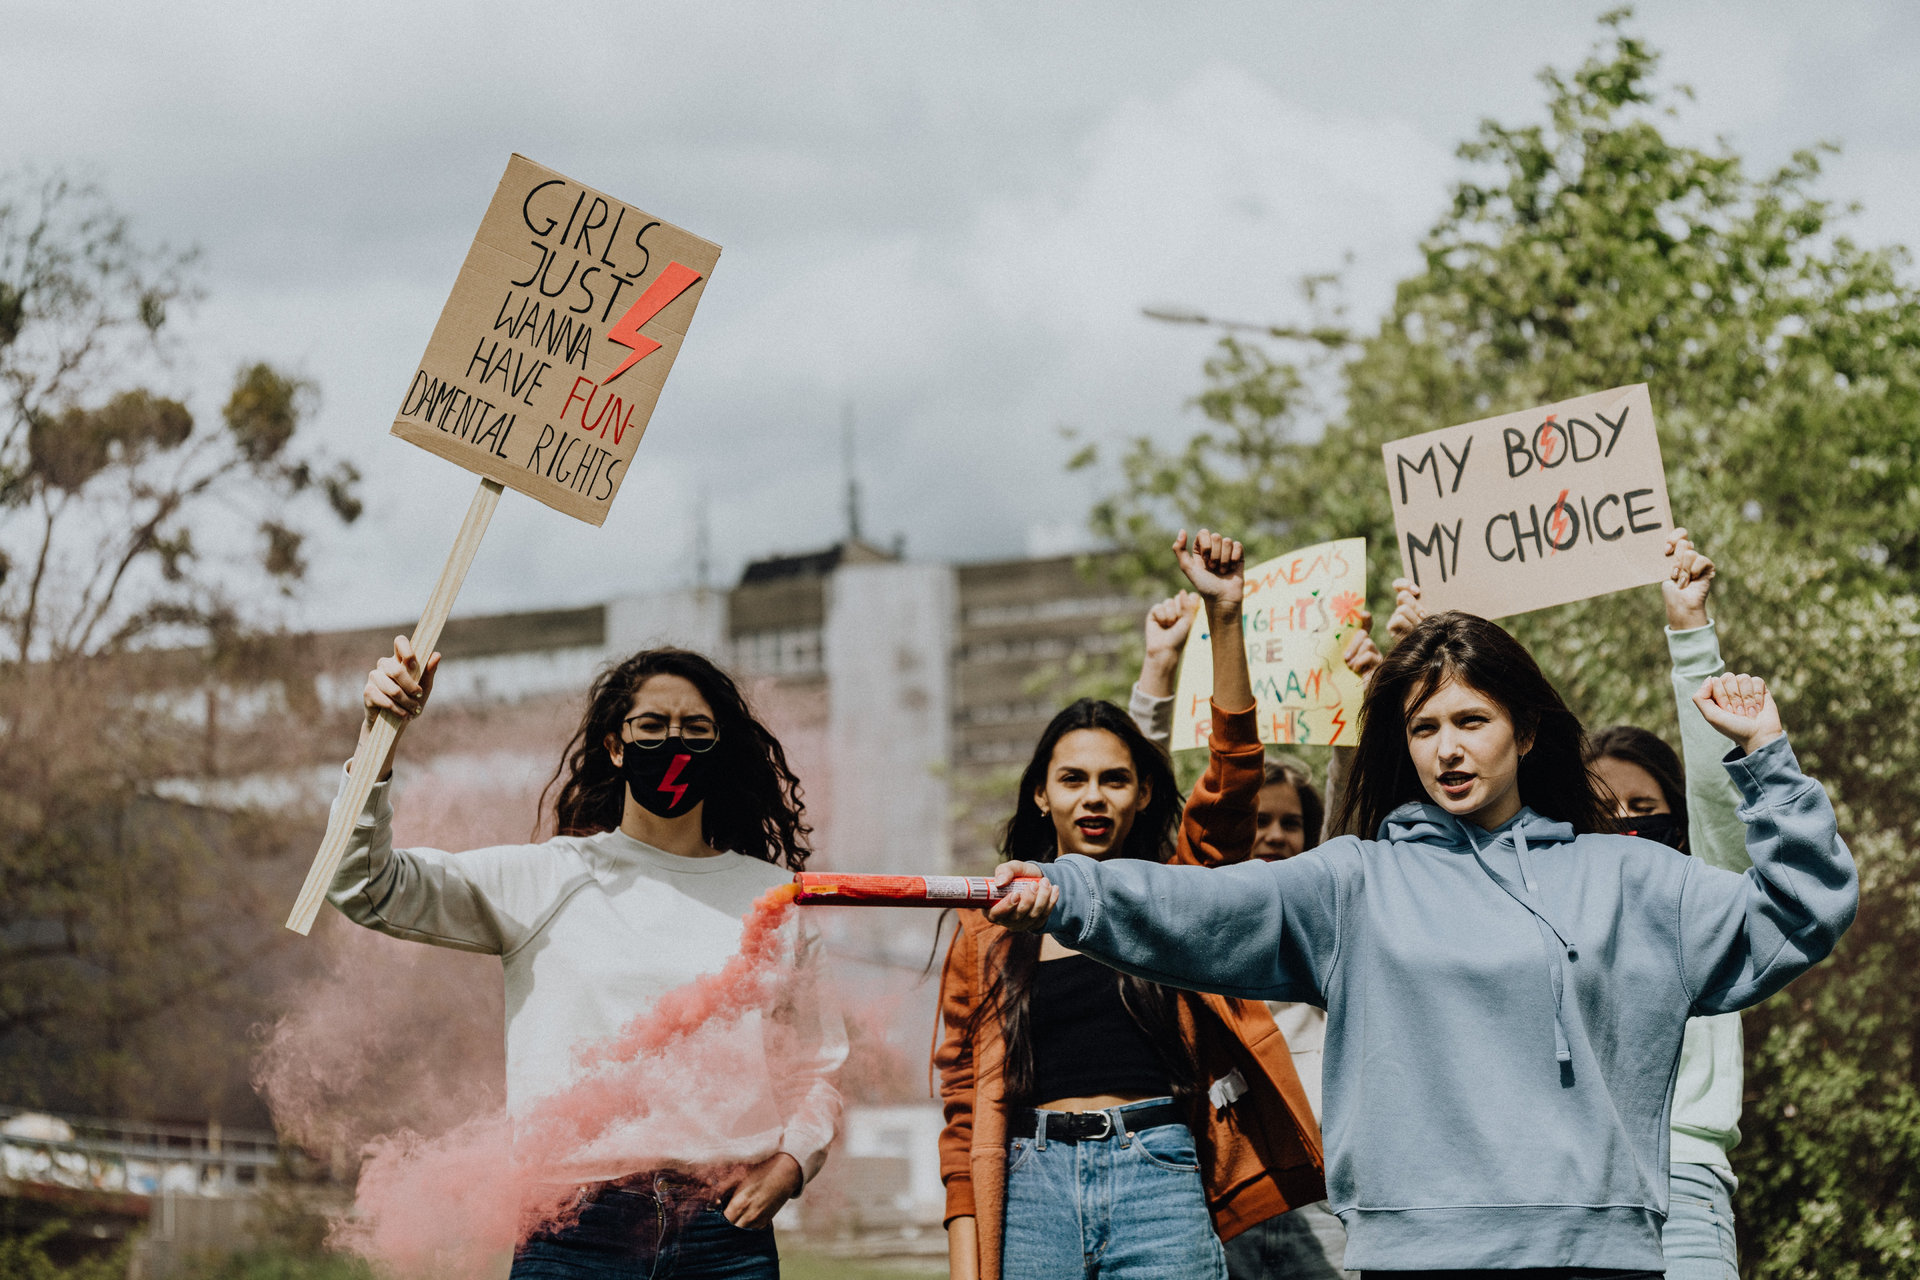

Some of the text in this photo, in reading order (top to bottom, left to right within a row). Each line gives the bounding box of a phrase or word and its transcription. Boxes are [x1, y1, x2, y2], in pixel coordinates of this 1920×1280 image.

[523, 180, 661, 278] GIRLS
[511, 240, 634, 322] JUST
[494, 291, 592, 371] WANNA
[401, 370, 622, 501] DAMENTAL RIGHTS
[466, 337, 635, 445] HAVE FUN-
[1397, 406, 1629, 505] MY BODY
[1407, 488, 1662, 587] MY CHOICE
[1242, 597, 1330, 637] IGHTS
[1249, 638, 1283, 664] RE
